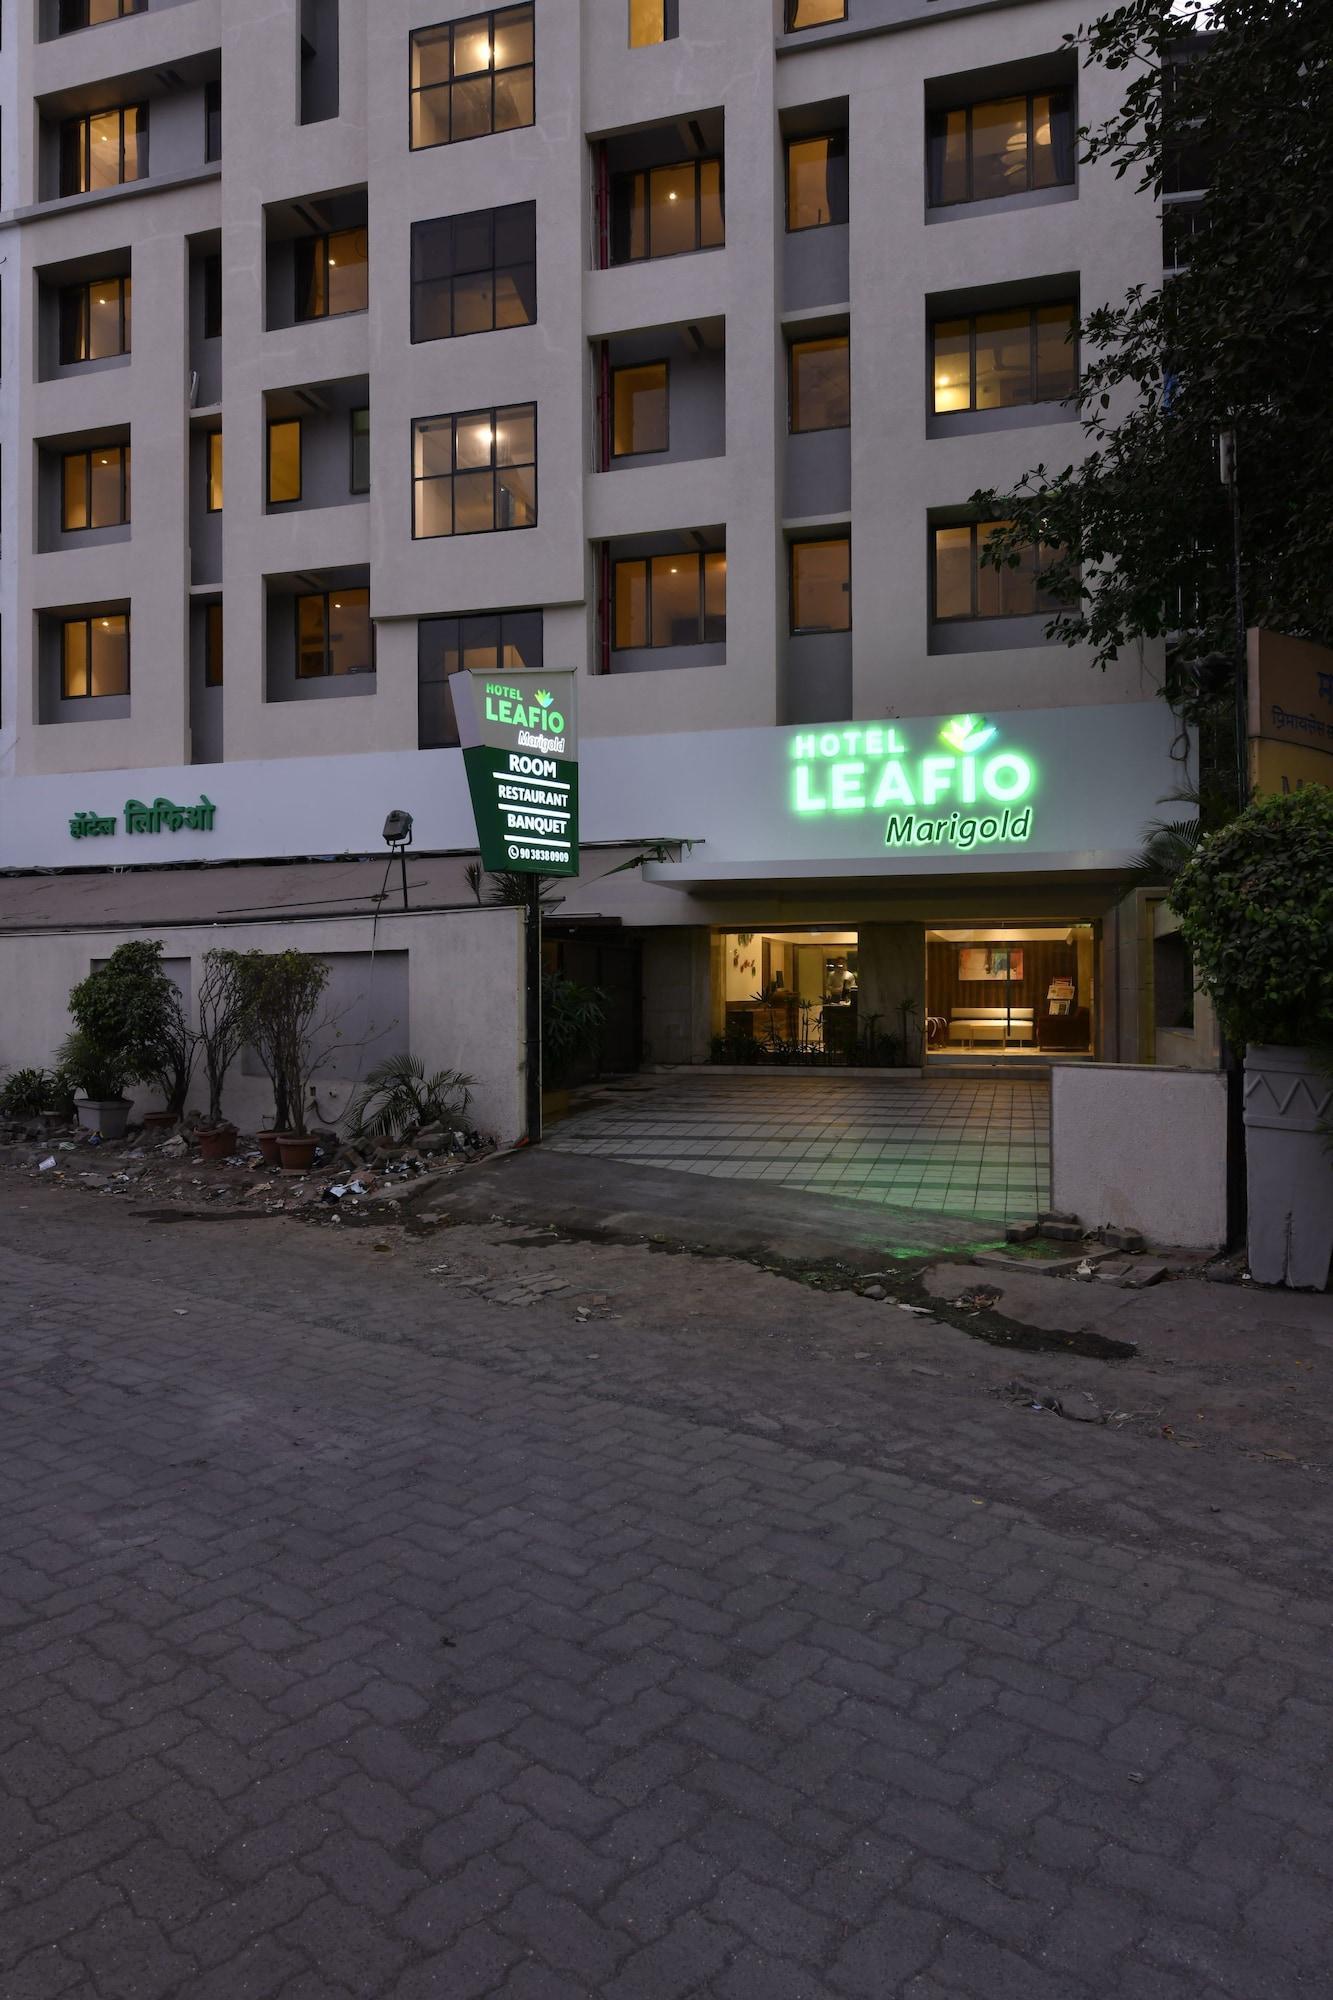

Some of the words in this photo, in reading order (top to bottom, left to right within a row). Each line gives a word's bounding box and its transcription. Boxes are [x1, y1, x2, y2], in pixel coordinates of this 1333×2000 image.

[486, 683, 523, 701] HOTEL
[486, 697, 565, 734] LEAFIO
[518, 730, 565, 753] Marigold
[794, 728, 905, 759] HOTEL
[509, 754, 557, 778] ROOM
[498, 784, 568, 807] RESTAURANT
[795, 753, 1031, 812] LEAFIO
[69, 811, 117, 839] हॉटेल
[507, 813, 568, 835] BANQUET
[885, 807, 1032, 849] Marigold
